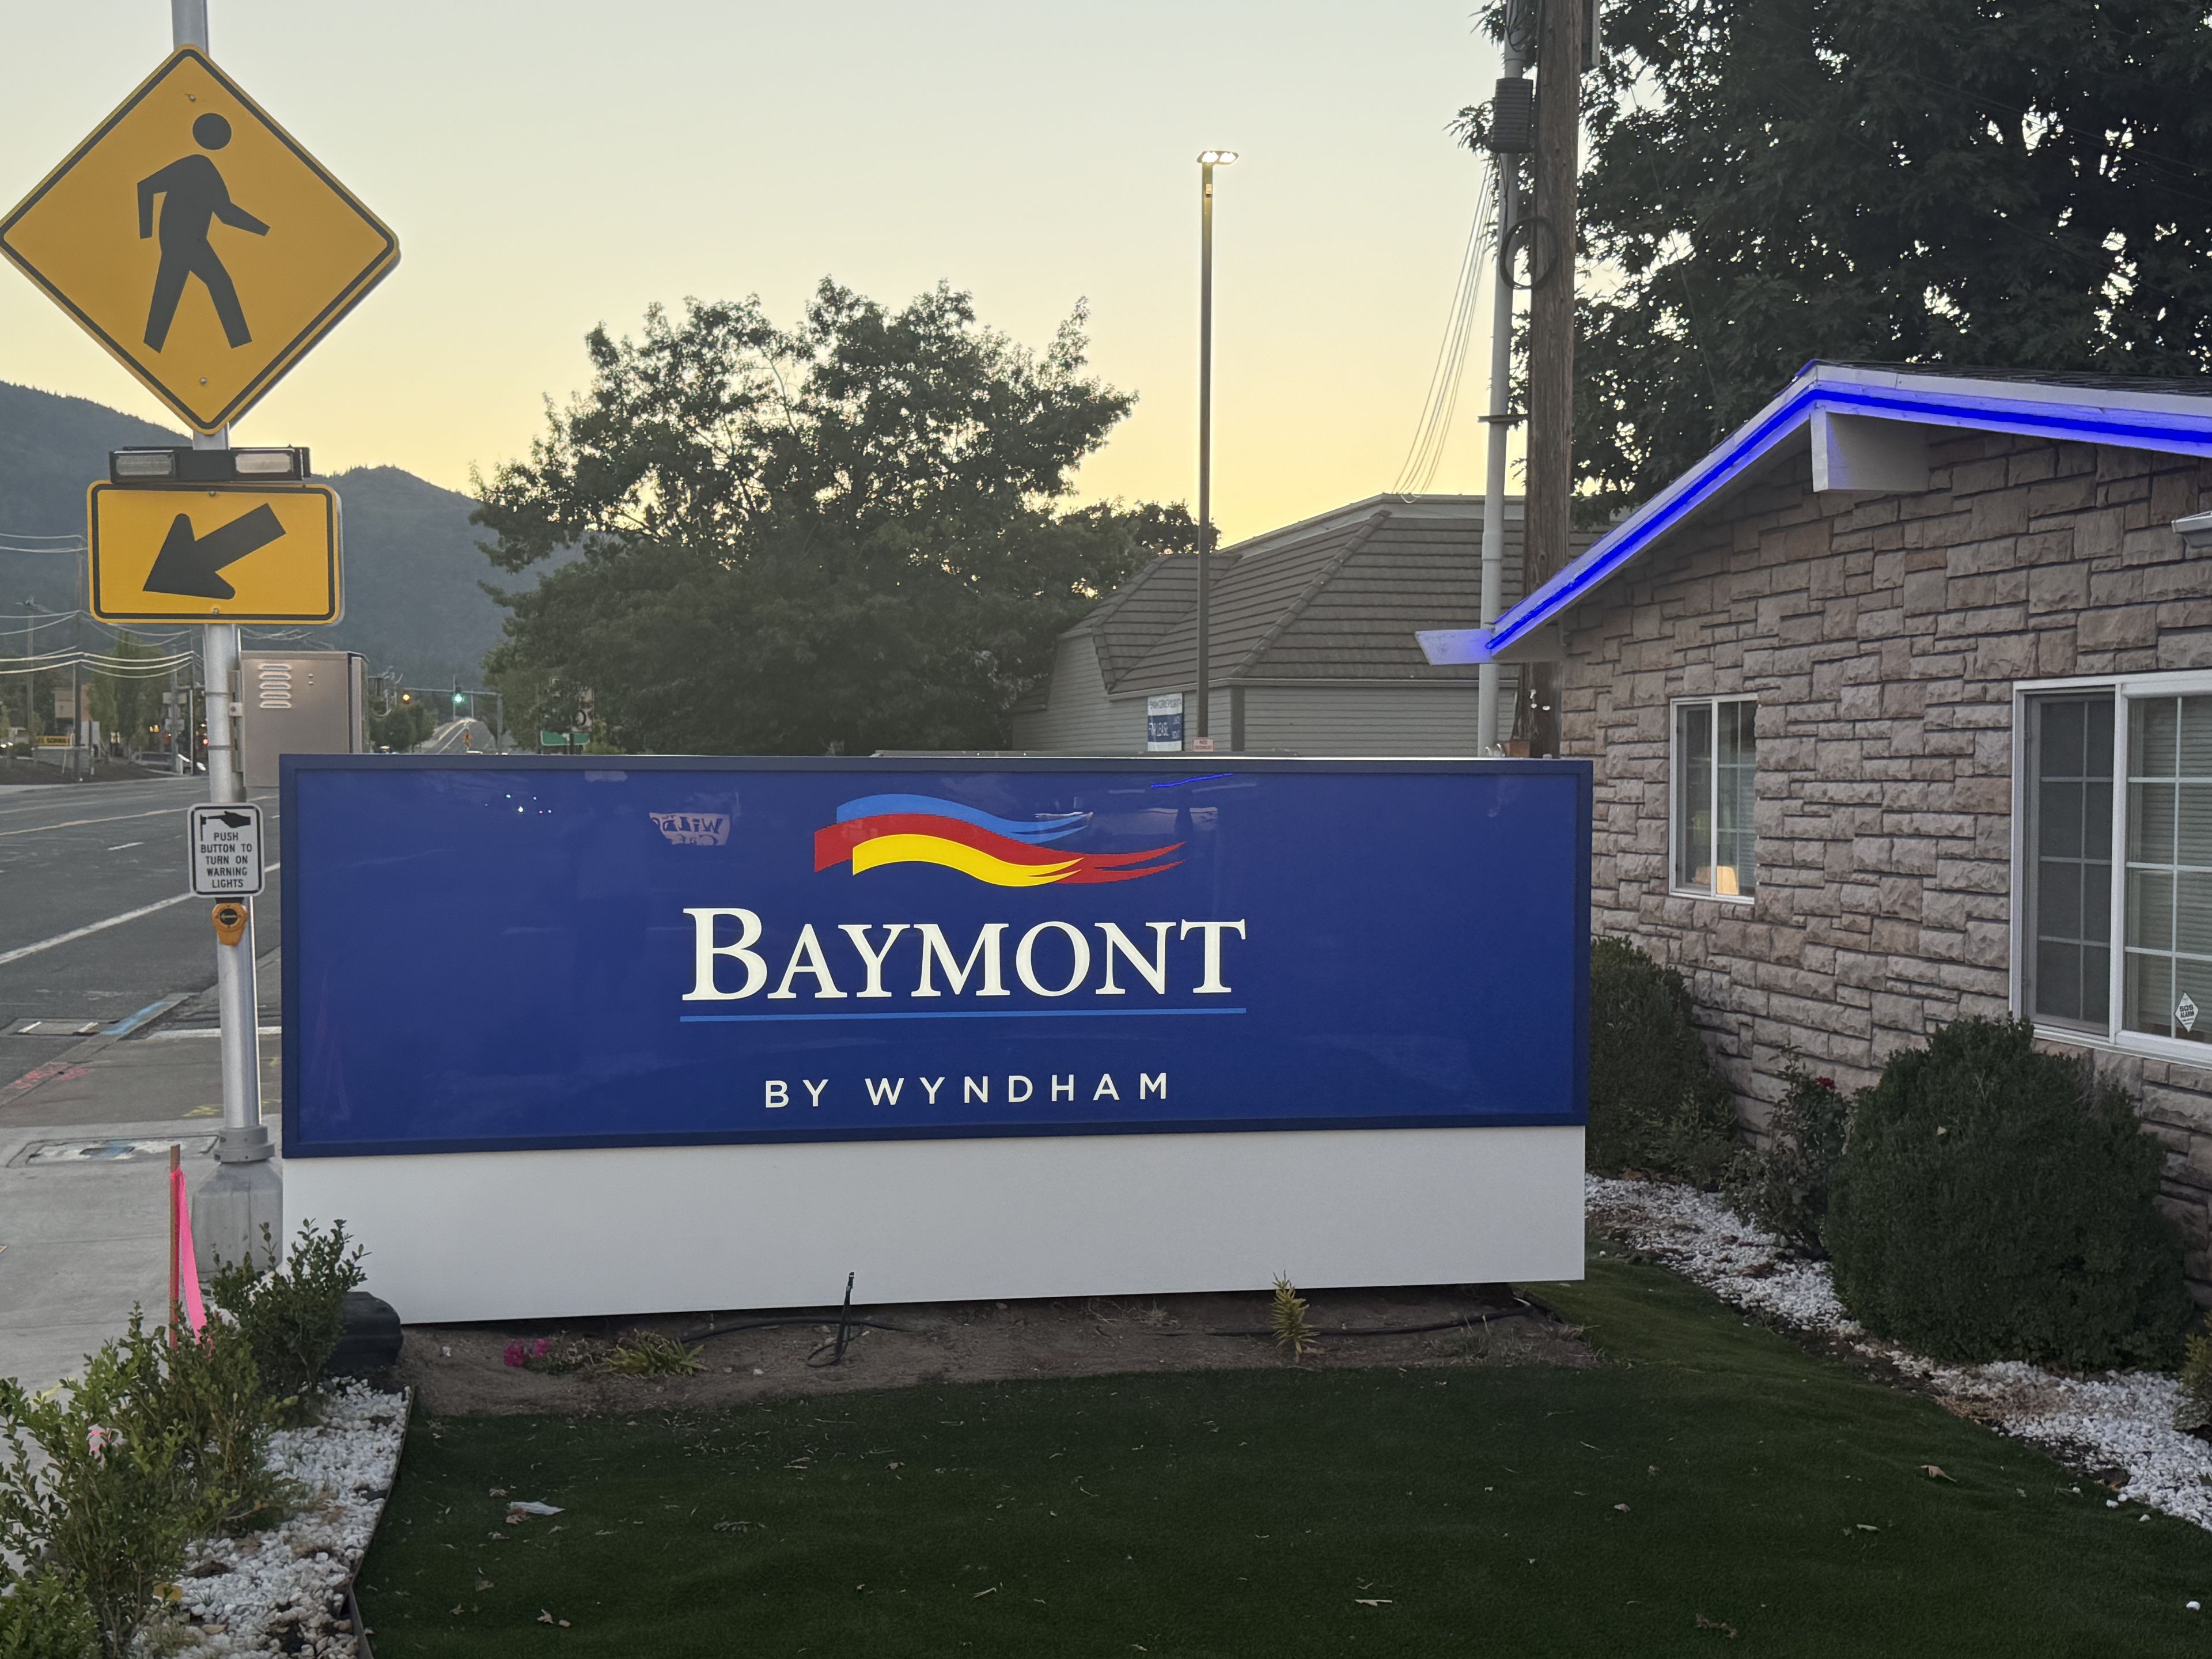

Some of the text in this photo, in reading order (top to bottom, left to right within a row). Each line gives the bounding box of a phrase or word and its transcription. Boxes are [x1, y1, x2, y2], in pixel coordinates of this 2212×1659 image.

[214, 832, 238, 841] PUSH
[200, 843, 252, 853] BUTTON TO
[206, 855, 248, 865] TURN ON
[207, 867, 248, 876] WARNING
[212, 879, 244, 888] LIGHTS
[683, 907, 1246, 1001] BAYMONT
[764, 1072, 1168, 1108] BY WYNDHAM
